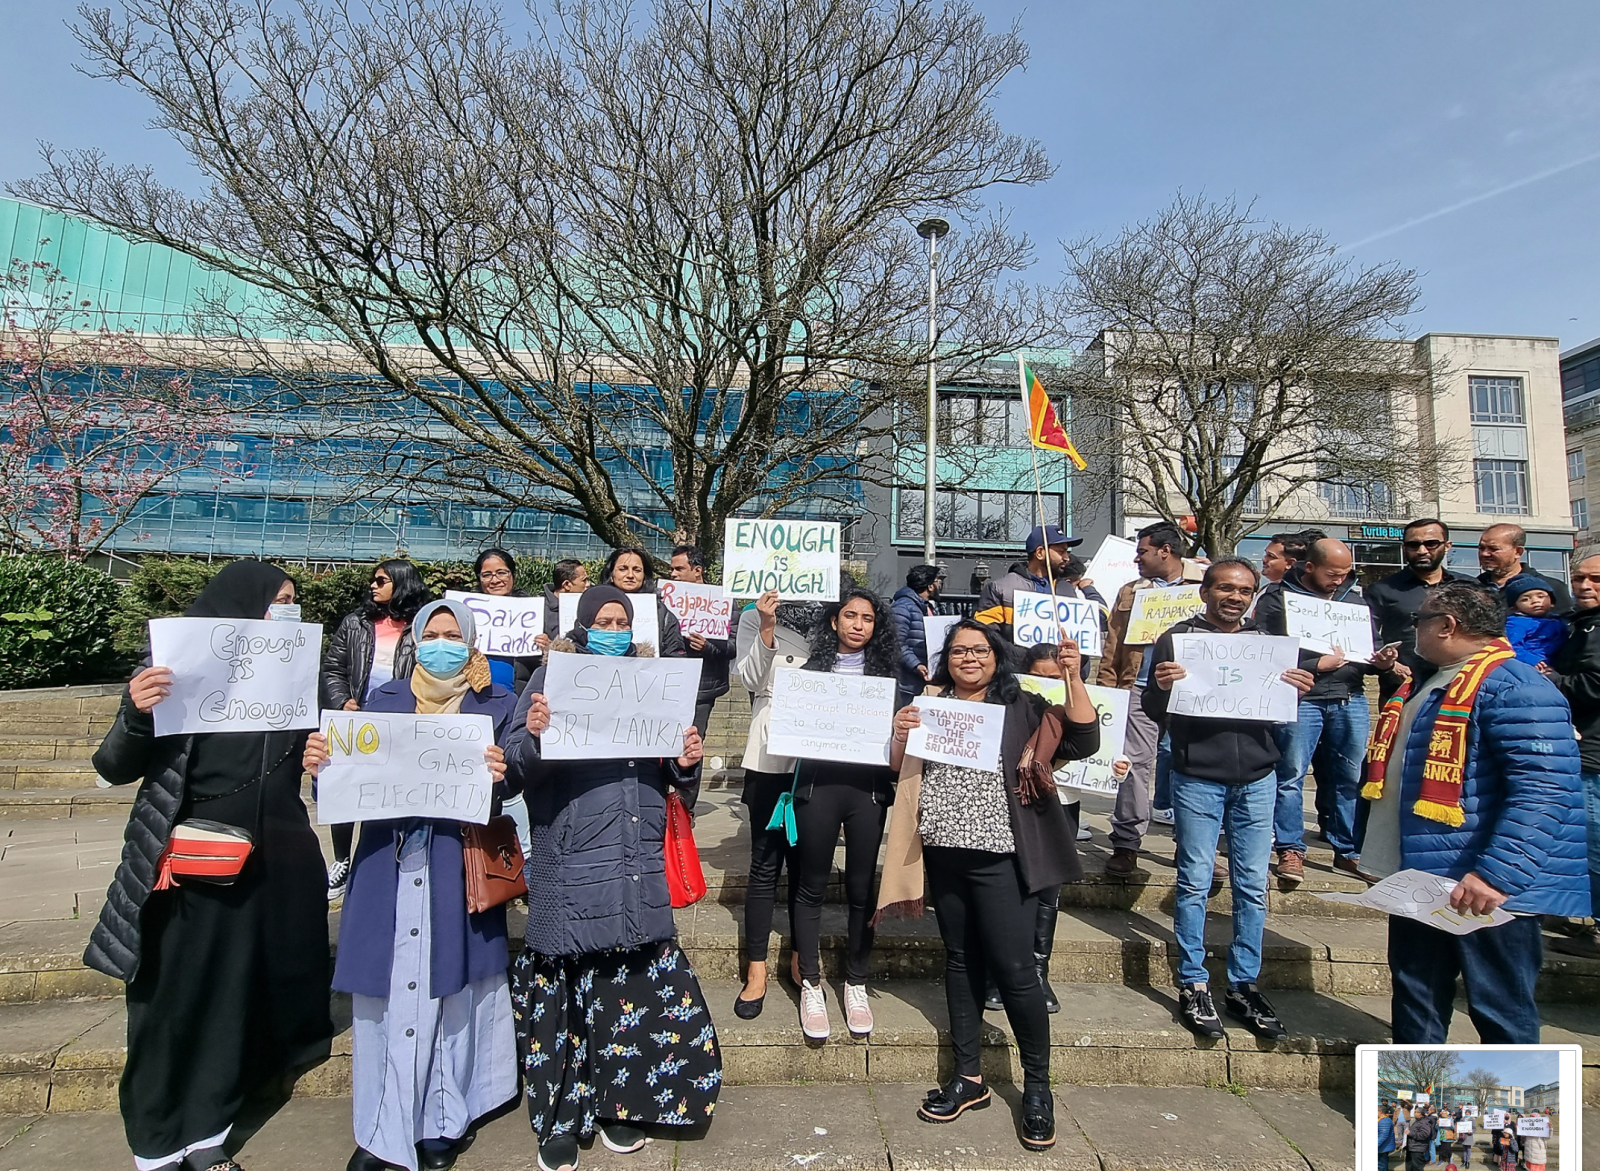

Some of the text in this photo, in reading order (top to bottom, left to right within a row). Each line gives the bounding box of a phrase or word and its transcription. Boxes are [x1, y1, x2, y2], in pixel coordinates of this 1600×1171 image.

[736, 522, 834, 553] ENOUGH
[1362, 526, 1388, 536] Turtle
[661, 582, 730, 619] Rajapaksa
[1163, 592, 1172, 602] to
[1177, 589, 1194, 600] end
[463, 597, 536, 628] Save
[1017, 598, 1098, 628] #GOTA
[1288, 600, 1318, 618] Send
[695, 619, 732, 636] DOWN
[1018, 624, 1042, 644] GO
[1300, 624, 1312, 638] to
[210, 623, 306, 662] Enough
[486, 629, 540, 654] Lanka
[1182, 639, 1275, 663] ENOUGH
[571, 664, 684, 703] SAVE
[788, 673, 886, 700] Don't let
[1218, 666, 1243, 686] IS
[199, 690, 308, 729] Enough
[797, 696, 840, 716] Corrupt
[846, 703, 890, 718] Politicians
[1174, 690, 1272, 717] ENOUGH
[794, 718, 866, 737] to fool you
[929, 708, 984, 724] STANDING
[937, 718, 975, 732] UP FOR
[326, 718, 482, 757] NO FOOD
[544, 711, 686, 749] SRI LANKA
[945, 728, 965, 739] THE
[924, 742, 979, 760] SRI LANKA
[926, 733, 982, 751] PEOPLE OF
[418, 748, 475, 776] GAS
